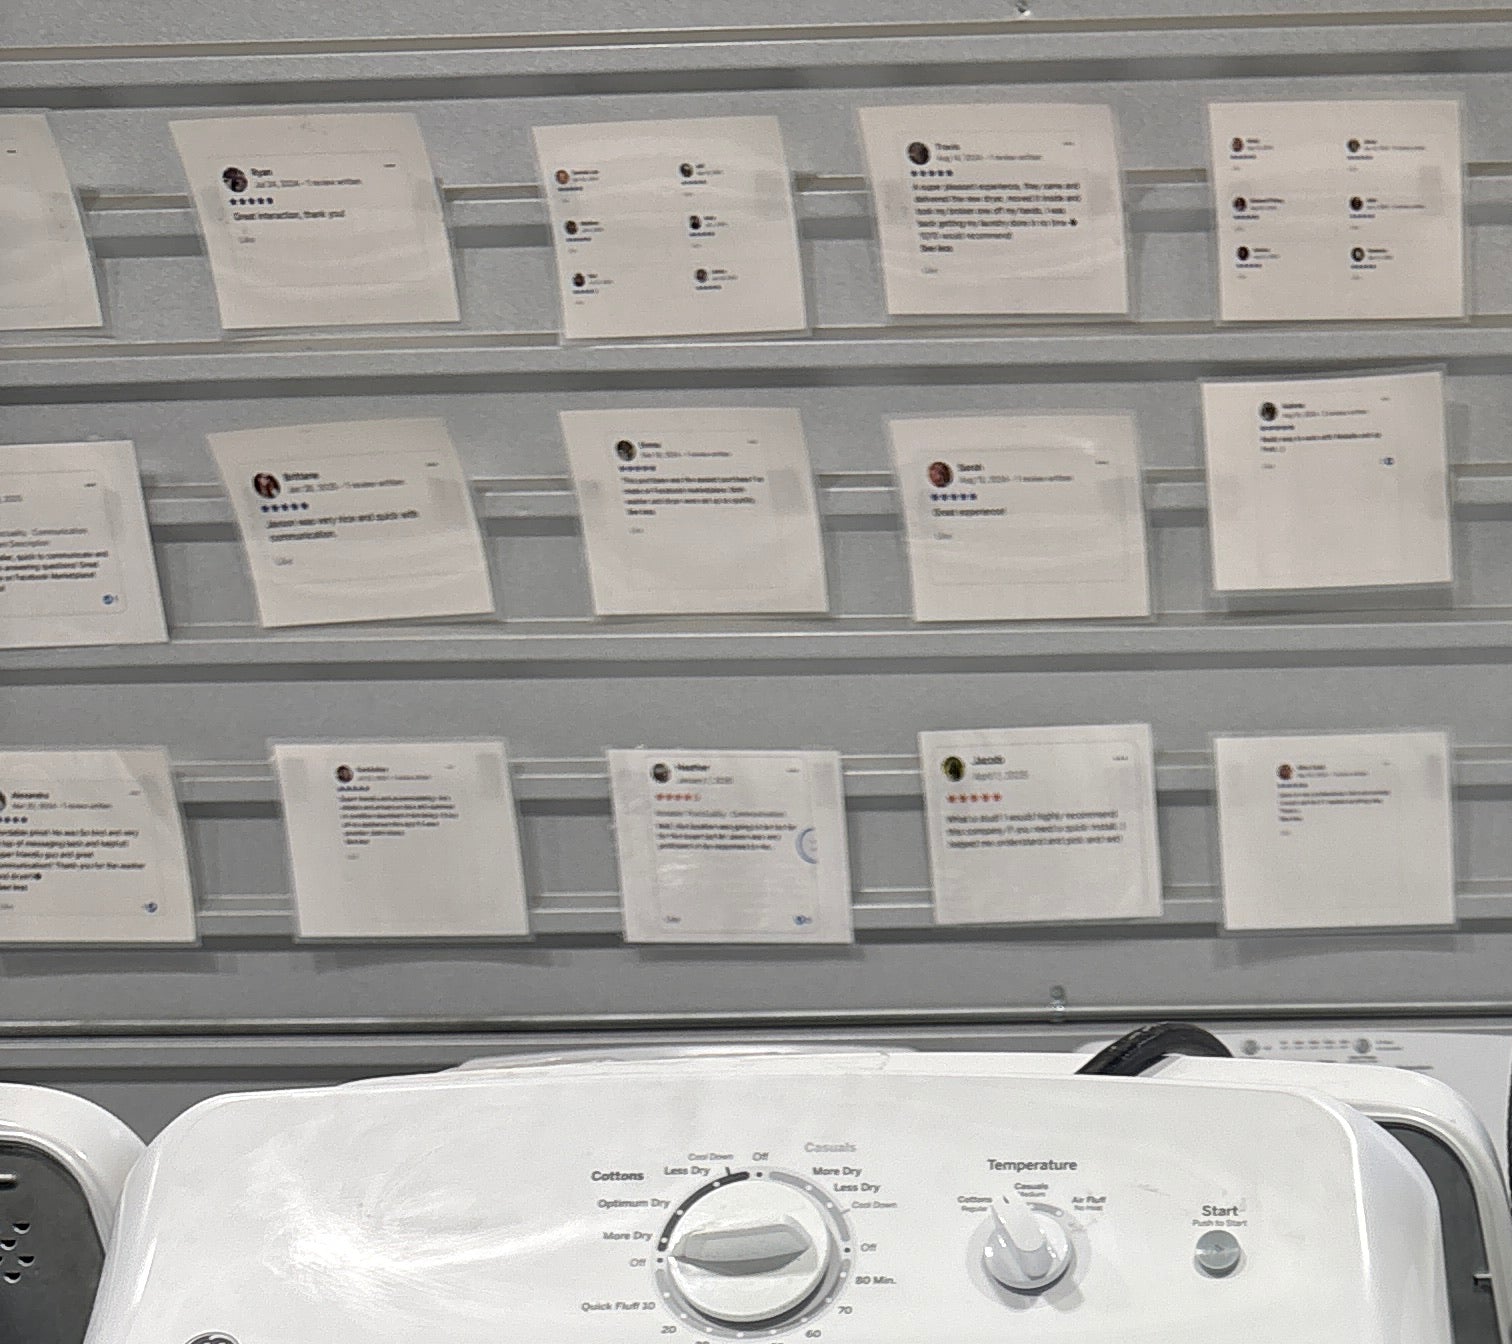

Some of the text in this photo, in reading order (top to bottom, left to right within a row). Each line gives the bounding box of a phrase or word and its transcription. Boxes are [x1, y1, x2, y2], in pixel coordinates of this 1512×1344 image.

[804, 1142, 857, 1152] Casuals
[688, 1153, 734, 1161] Cool Down
[752, 1152, 769, 1161] Off
[987, 1159, 1077, 1173] Temperature
[591, 1171, 644, 1182] Cottons
[664, 1166, 711, 1177] Less Dry
[813, 1166, 862, 1178] More Dry
[834, 1182, 881, 1194] Less Dry
[597, 1198, 670, 1210] Optimum Dry
[1202, 1205, 1238, 1217] Start
[1225, 1219, 1247, 1227] Start
[603, 1231, 653, 1242] More Dry
[861, 1243, 877, 1252] Off
[630, 1257, 646, 1267] Off
[874, 1276, 896, 1285] Min.
[582, 1302, 612, 1312] Quick
[615, 1301, 640, 1310] Fluff
[838, 1306, 852, 1315] 70
[661, 1326, 676, 1334] 20
[805, 1330, 821, 1338] 60
